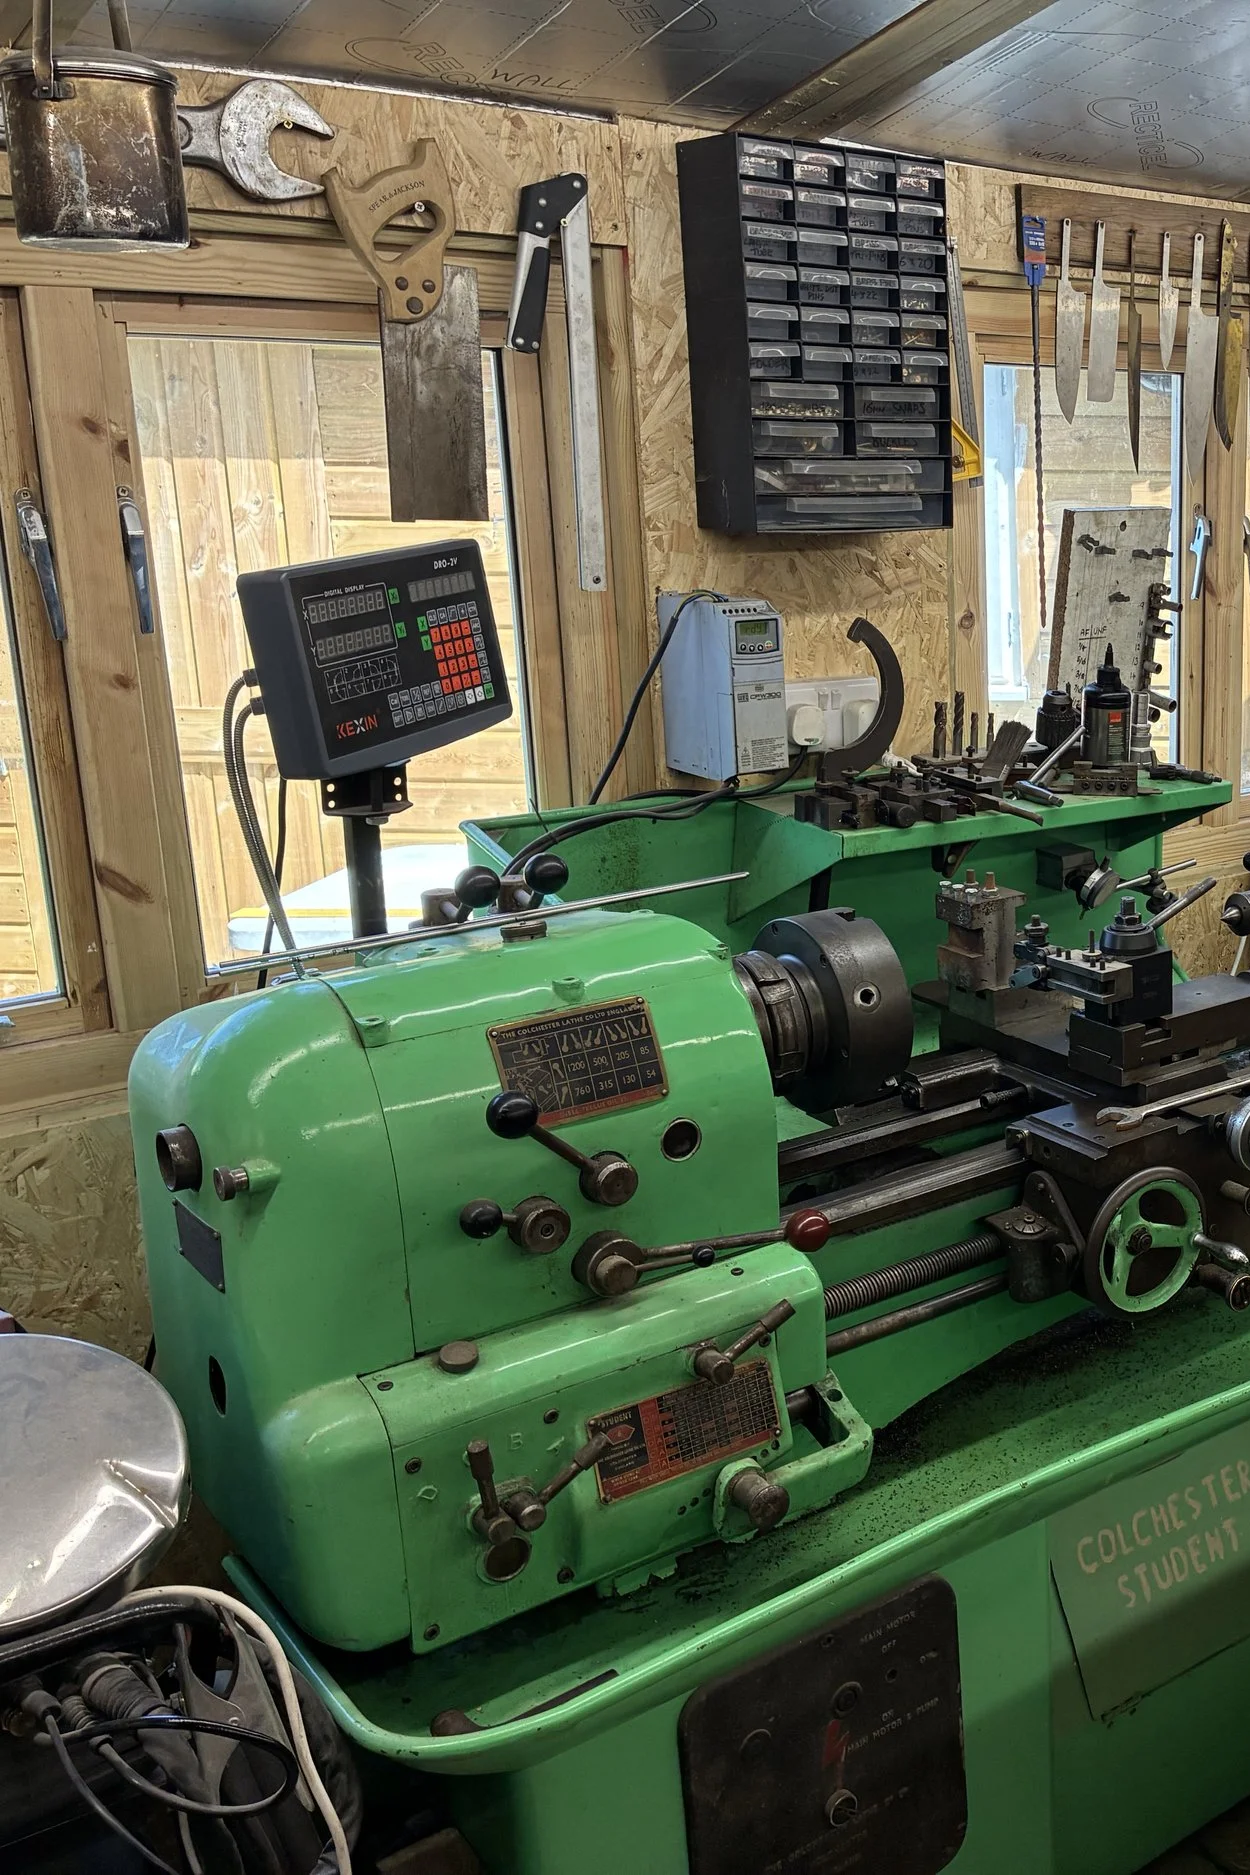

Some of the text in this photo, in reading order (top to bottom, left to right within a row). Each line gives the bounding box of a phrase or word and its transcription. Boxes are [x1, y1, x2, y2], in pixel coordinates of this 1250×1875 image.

[490, 67, 579, 92] WALL
[1129, 100, 1170, 172] RECTICEL
[1028, 148, 1096, 165] WALL
[368, 194, 389, 213] SPEAR
[394, 180, 425, 196] JACKSON
[893, 402, 926, 414] SNAPS
[434, 558, 458, 570] DRO-2V
[324, 584, 365, 598] DIGITAL DISPLAY
[1094, 626, 1107, 634] UNF
[336, 715, 378, 739] KEXIN
[501, 1030, 516, 1040] THE
[517, 1020, 560, 1036] COLCHESTER
[561, 1016, 584, 1026] LATHE
[568, 1046, 650, 1073] 1200 500 205 85
[575, 1070, 656, 1096] 760 315 130 54
[510, 1432, 523, 1450] B
[1117, 1517, 1242, 1608] STUDENT
[885, 1611, 917, 1632] MOTOR
[846, 1737, 869, 1754] MAIN
[872, 1717, 904, 1740] MOTOR
[916, 1697, 940, 1717] PUMP
